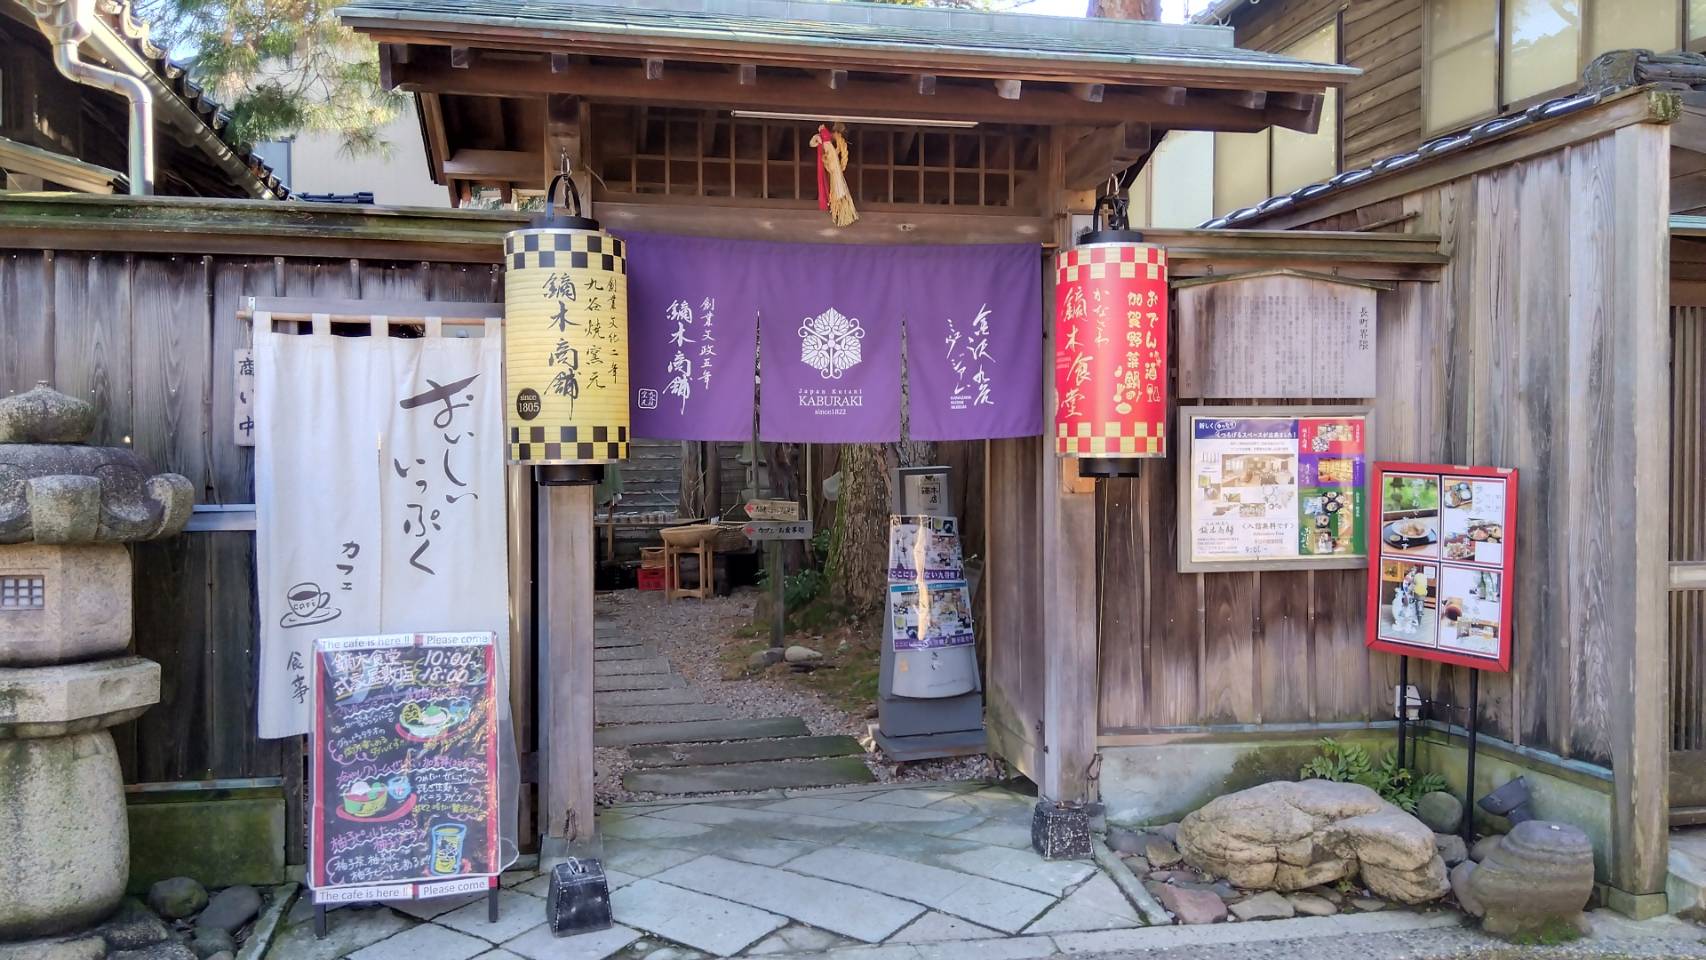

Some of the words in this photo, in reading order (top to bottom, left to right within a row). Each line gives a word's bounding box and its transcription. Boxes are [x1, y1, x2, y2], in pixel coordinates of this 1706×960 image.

[698, 296, 717, 390] 創業文政五年
[518, 401, 540, 413] 1805
[798, 395, 863, 407] KABURAKI
[400, 373, 481, 504] おいしい
[394, 457, 442, 576] いっぷく
[336, 541, 361, 591] カフェ
[343, 637, 366, 649] cafe
[426, 634, 458, 646] Please
[287, 651, 310, 705] 食事
[320, 890, 339, 901] The
[341, 889, 364, 900] cafe
[366, 888, 373, 899] is
[376, 887, 396, 898] here
[423, 882, 451, 896] Please
[453, 881, 486, 892] come
